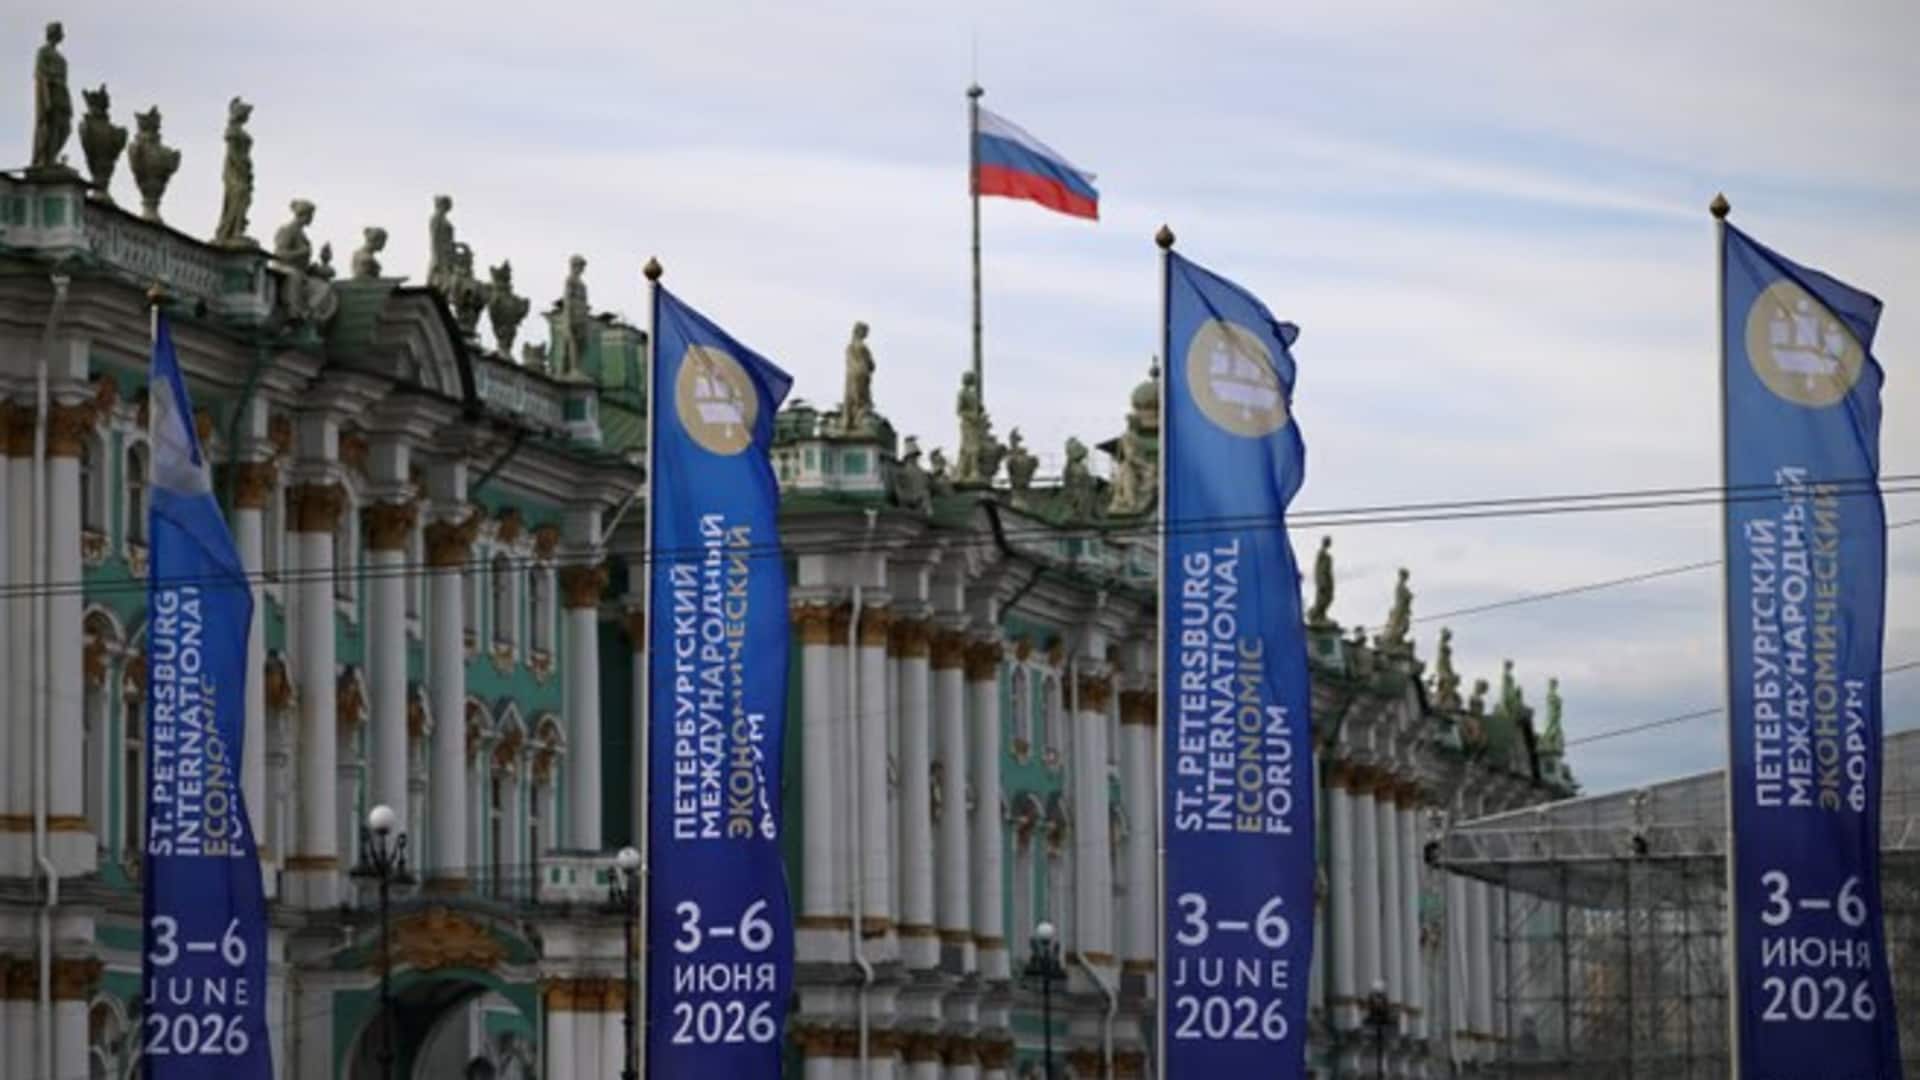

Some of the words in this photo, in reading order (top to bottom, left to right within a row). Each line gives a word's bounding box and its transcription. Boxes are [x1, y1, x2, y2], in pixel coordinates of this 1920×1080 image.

[701, 513, 726, 838] МЕЖДУНАРОДНЫЙ
[1178, 551, 1211, 776] PETERSBURG
[1745, 518, 1782, 807] ПЕТЕРБУРГСКИЙ
[1777, 465, 1813, 807] МЕЖДУНАРОДНЫЙ
[1810, 482, 1840, 813] ЭКОНОМИЧЕСКИЙ
[152, 589, 179, 803] PETERSBURG
[669, 563, 698, 839] ПЕТЕРБУРГСКИЙ
[1206, 538, 1240, 831] INTERNATIONAL
[1237, 637, 1264, 833] ECONOMIC
[1266, 705, 1292, 835] FORUM
[149, 810, 174, 856] ST.
[1176, 783, 1203, 831] ST.
[144, 977, 249, 1006] JUNE
[674, 963, 775, 993] ИЮНЯ
[1173, 957, 1289, 988] JUNE
[1761, 937, 1871, 969] ИЮНЯ
[145, 1013, 250, 1055] 2026
[672, 1001, 776, 1044] 2026
[1175, 995, 1289, 1040] 2026
[1762, 976, 1876, 1022] 2026
